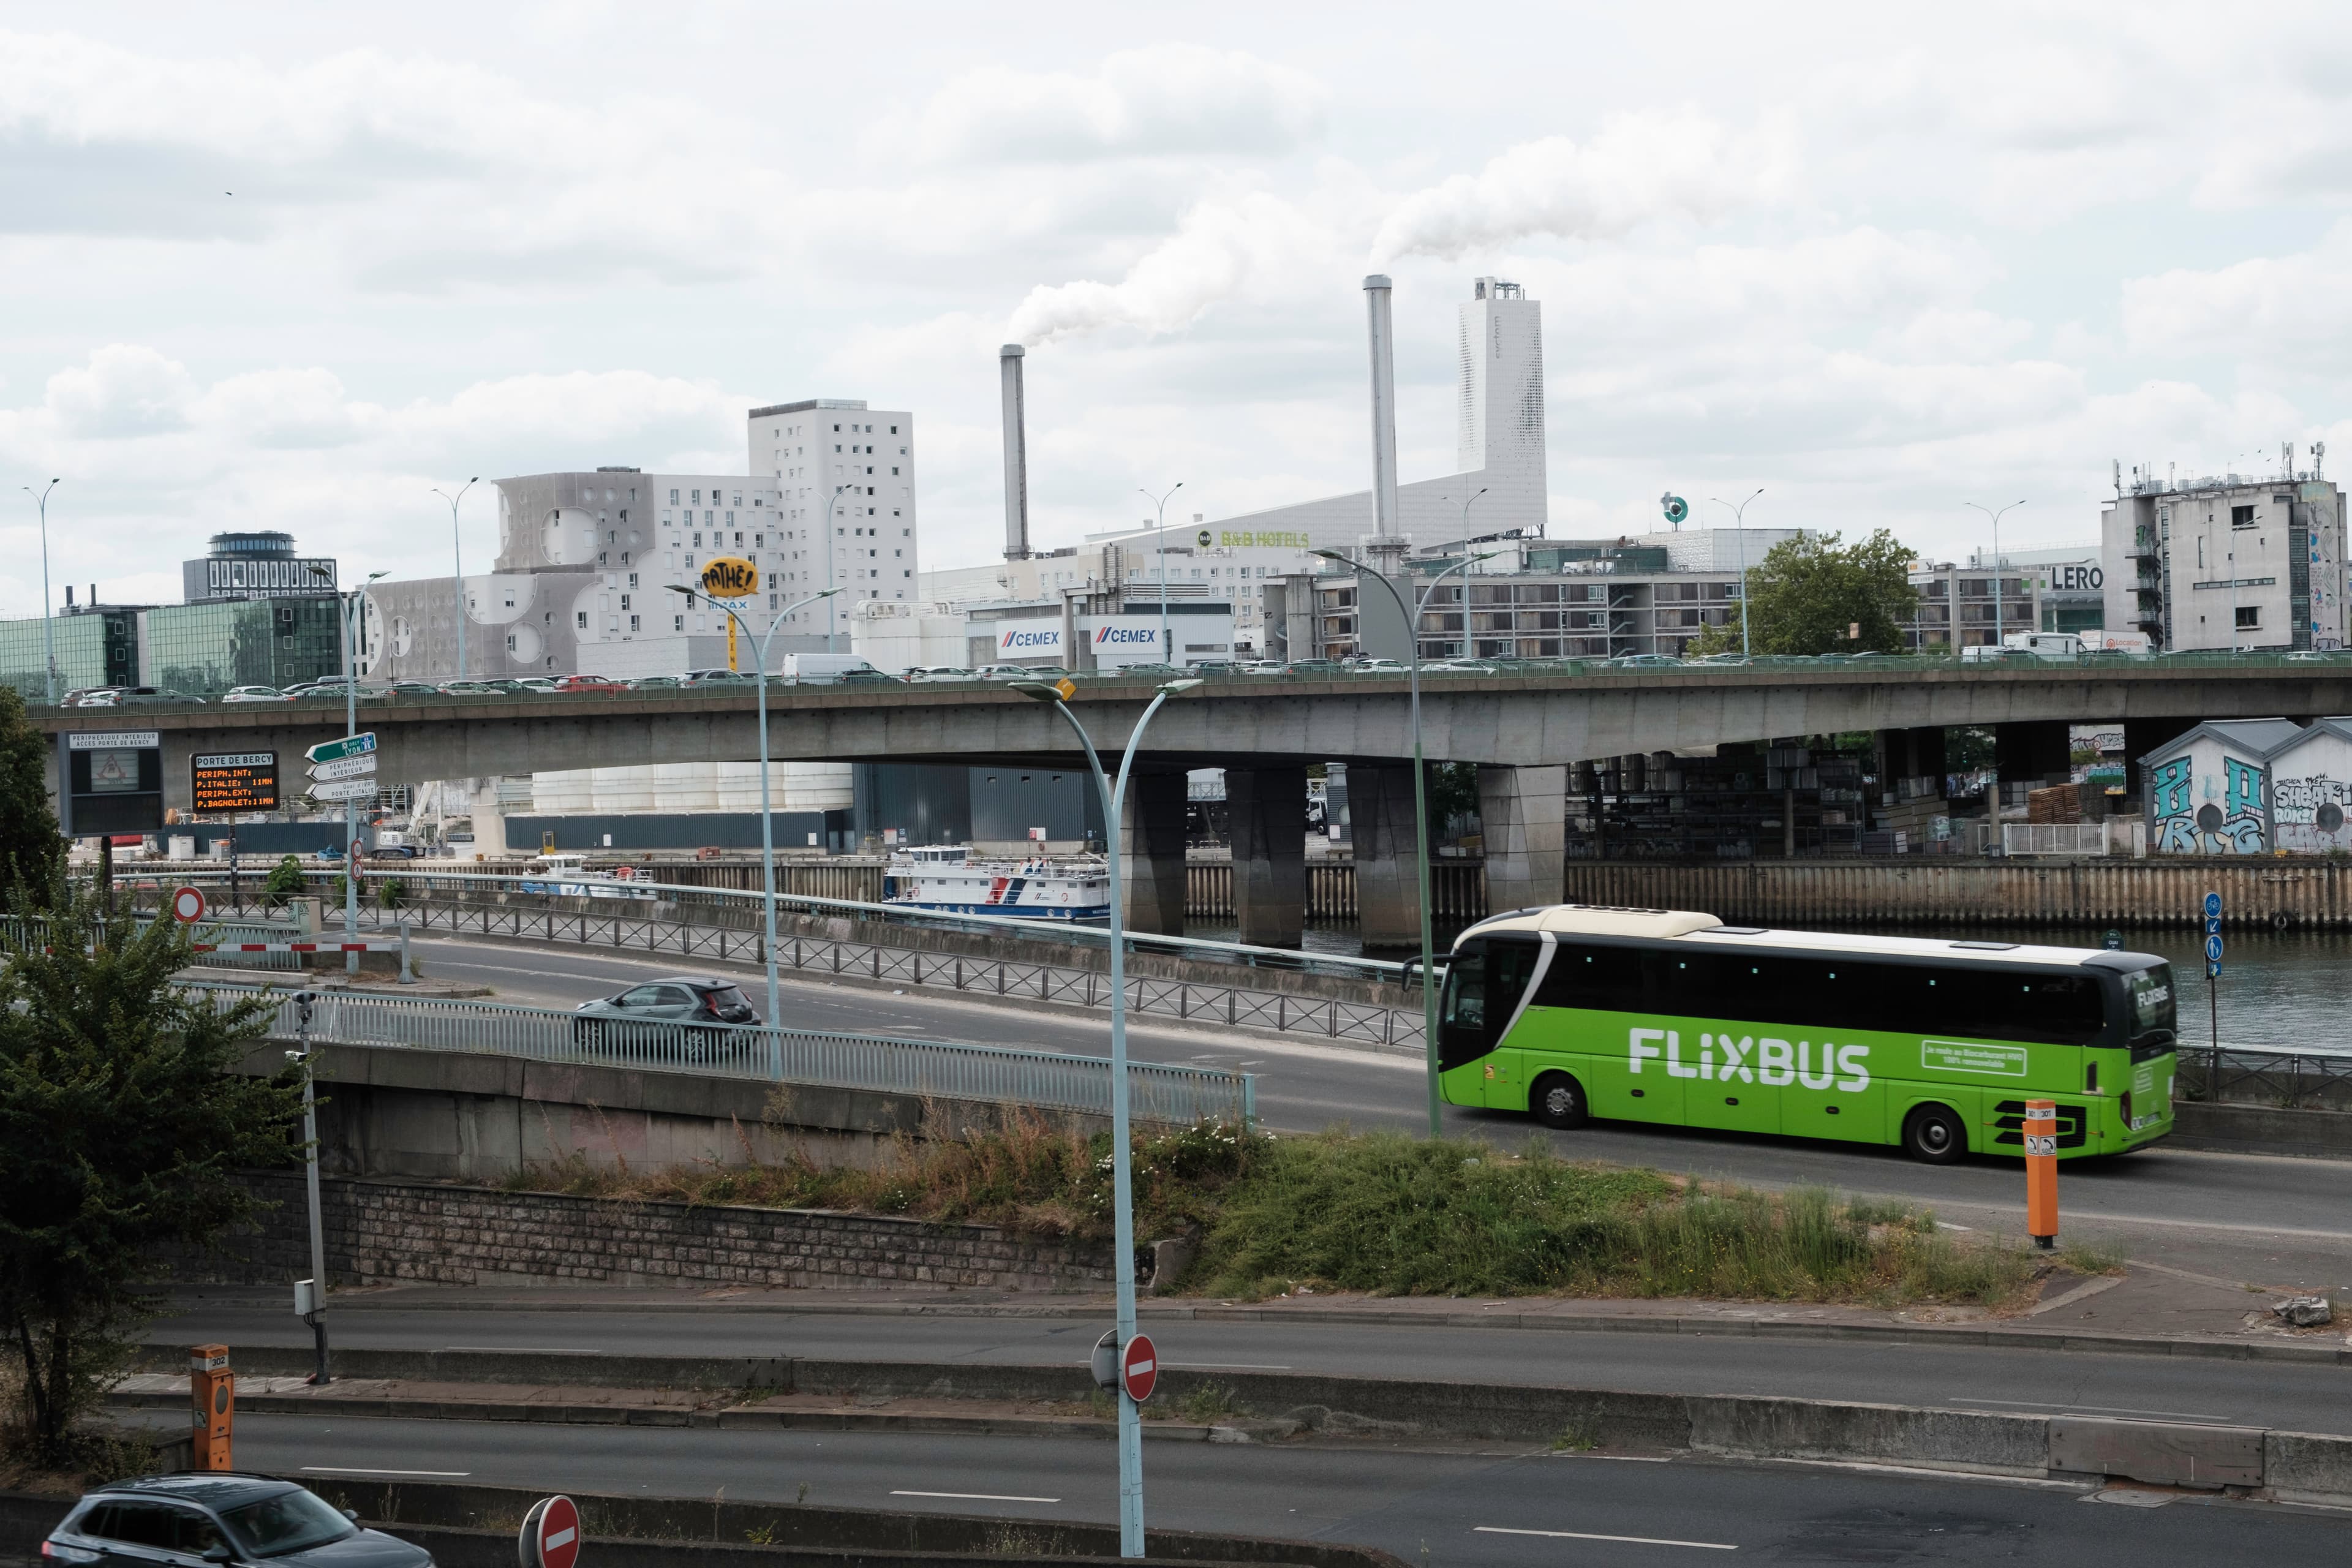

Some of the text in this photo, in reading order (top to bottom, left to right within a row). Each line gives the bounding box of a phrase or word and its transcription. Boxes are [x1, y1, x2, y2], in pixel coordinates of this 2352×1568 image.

[1222, 532, 1309, 548] B&B HOTELS
[1016, 631, 1059, 646] CEMEX
[1111, 630, 1156, 643] CEMEX
[345, 747, 361, 755] LYON
[197, 757, 225, 766] PORTE
[330, 758, 373, 770] PÉRIPHÉRIQUE
[331, 766, 363, 777] INTÉRIEUR
[212, 1356, 225, 1366] 302
